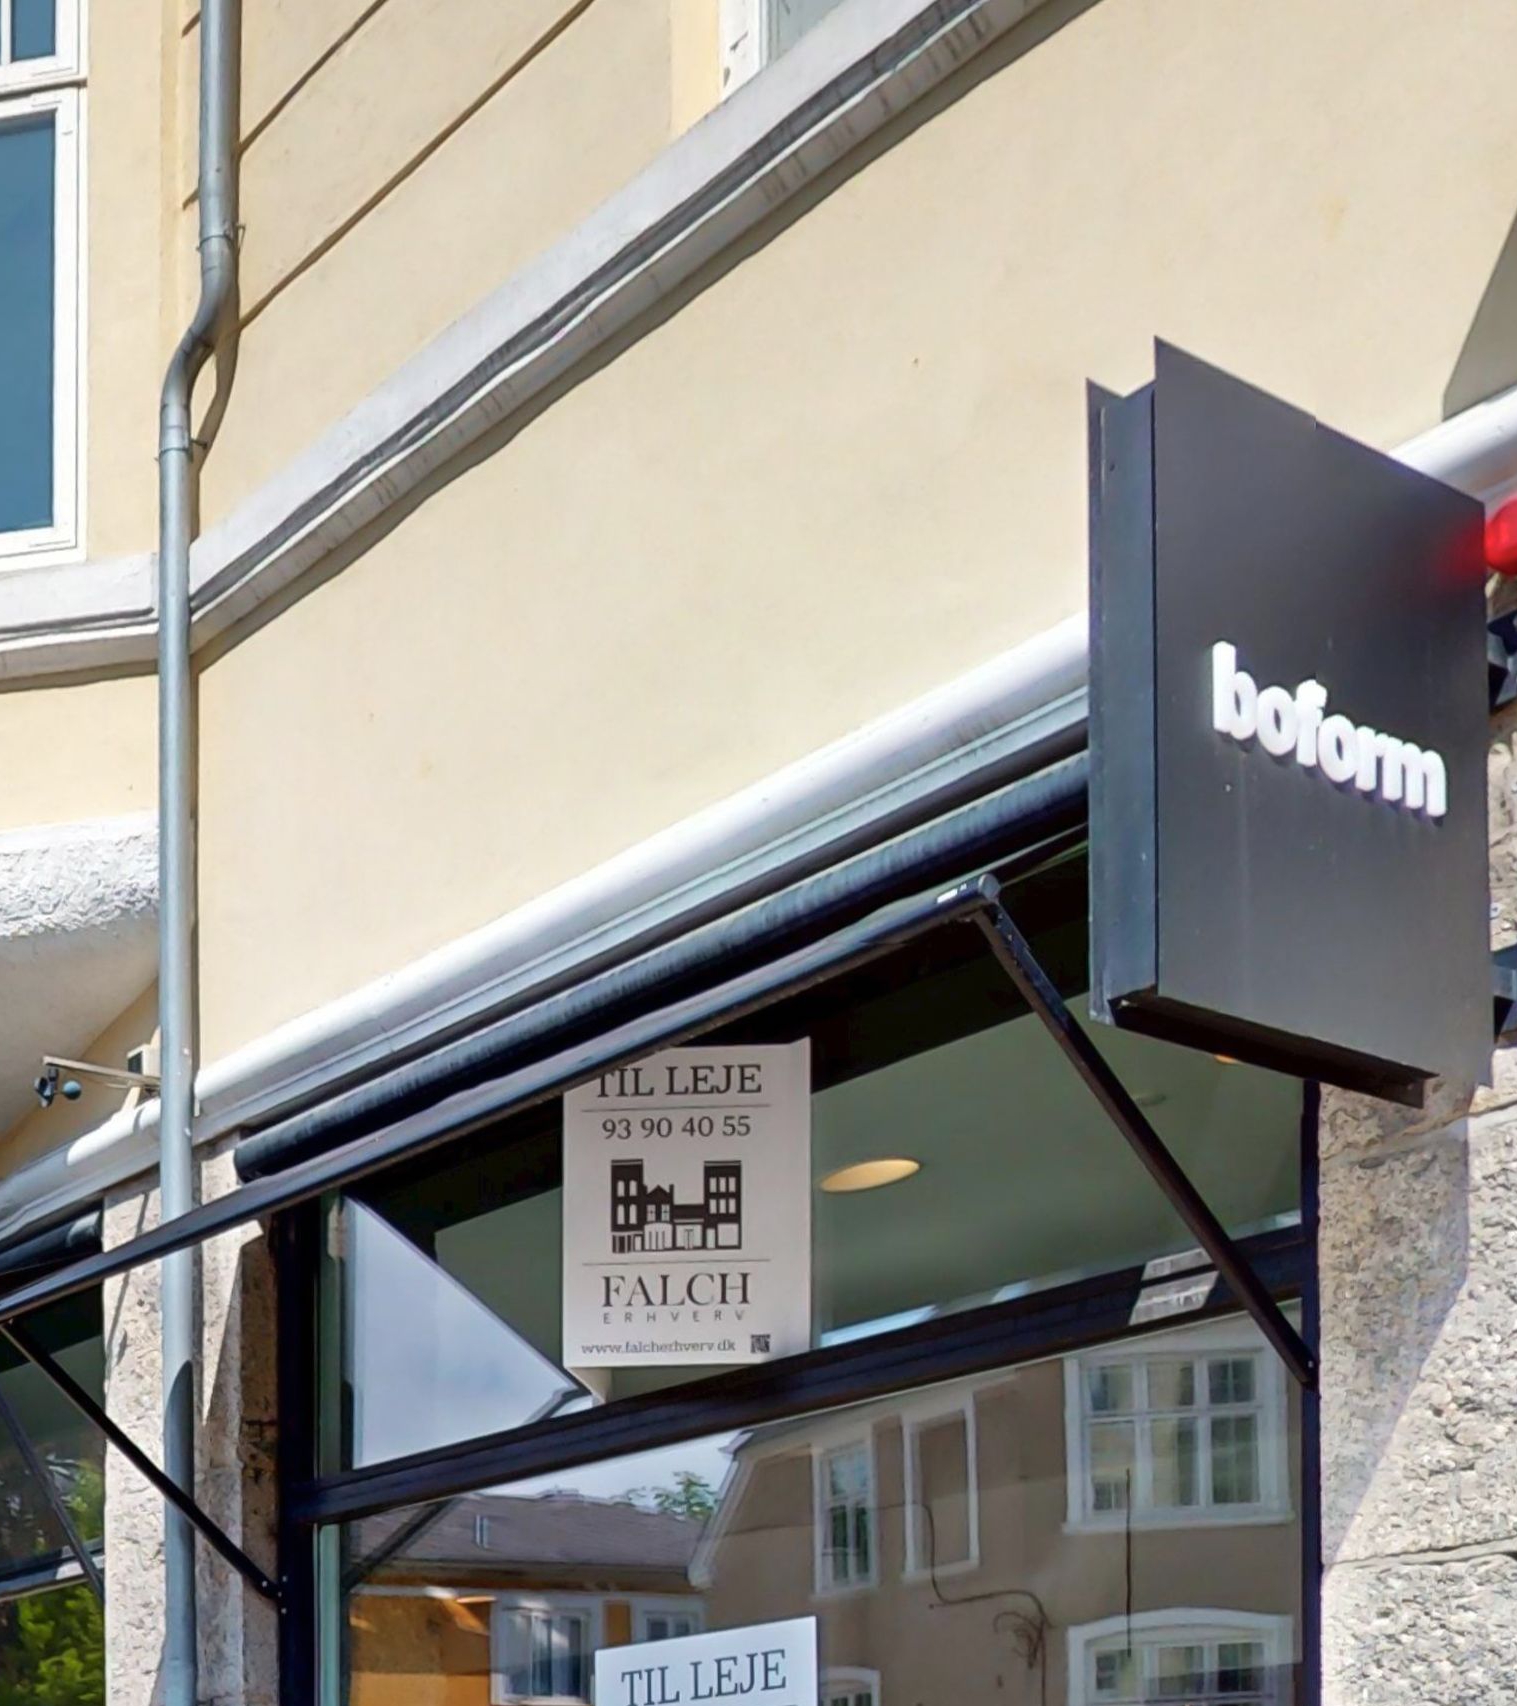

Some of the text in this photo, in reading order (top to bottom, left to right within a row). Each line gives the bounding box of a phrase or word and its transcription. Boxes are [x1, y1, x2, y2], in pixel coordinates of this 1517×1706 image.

[1211, 640, 1447, 822] boform
[597, 1063, 763, 1098] TIL LEJE
[602, 1115, 752, 1140] 93 90 40 55
[601, 1272, 752, 1308] FALCH
[603, 1310, 745, 1325] ERHVERV
[689, 1649, 787, 1701] LEJE
